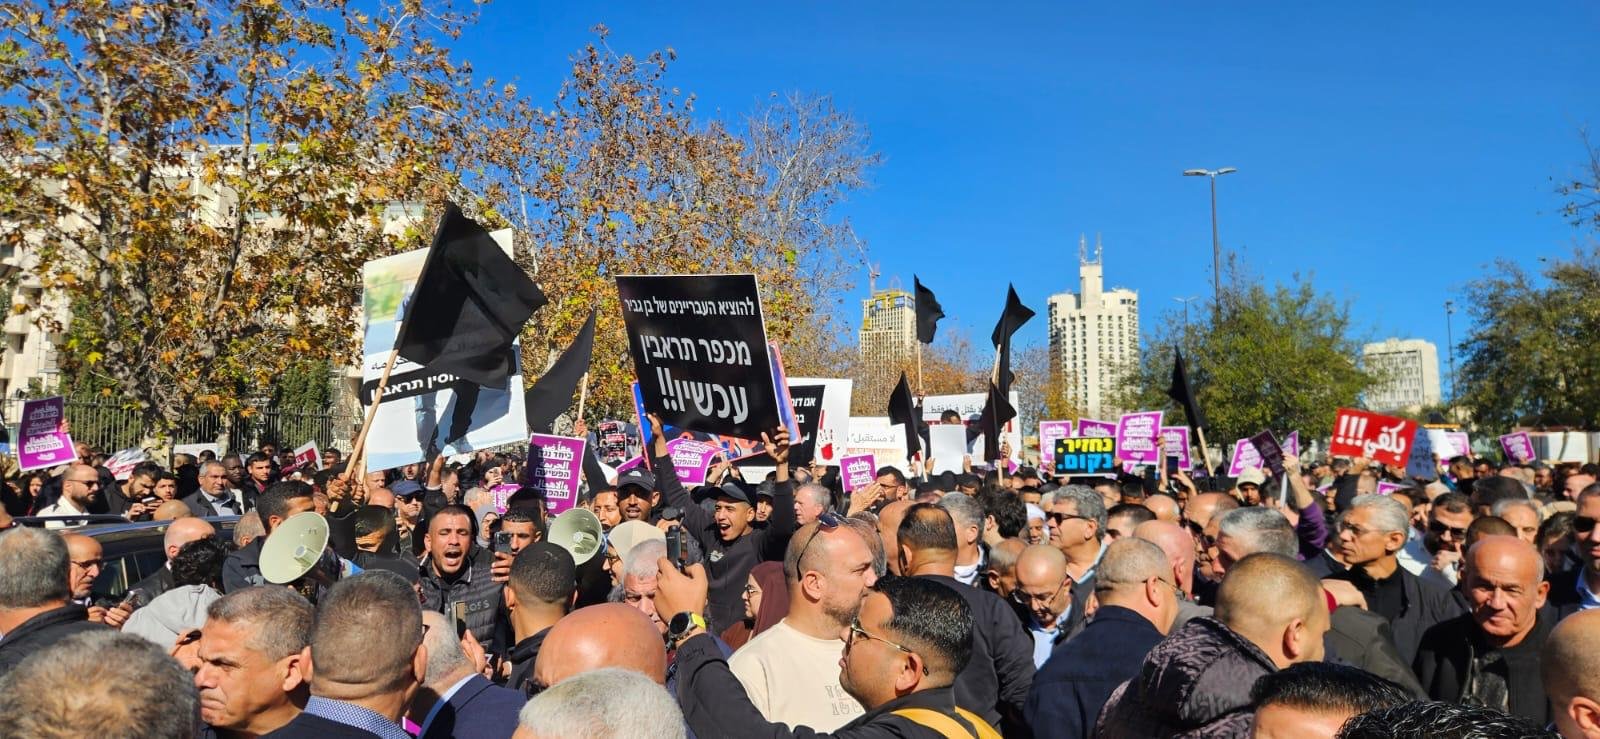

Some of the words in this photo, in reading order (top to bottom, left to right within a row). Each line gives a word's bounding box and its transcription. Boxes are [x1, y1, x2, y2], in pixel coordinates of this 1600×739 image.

[624, 298, 644, 312] גביר
[644, 299, 654, 317] בן
[653, 296, 667, 313] של
[669, 299, 717, 317] העבריינים
[719, 296, 755, 316] להוציא
[640, 334, 698, 364] תראבין
[698, 338, 752, 366] מכפר
[370, 379, 424, 401] תראבן
[427, 373, 460, 389] וסין
[656, 366, 749, 425] עכשיו!!
[1057, 437, 1113, 453] נחזיר.
[1057, 454, 1113, 474] נקום.
